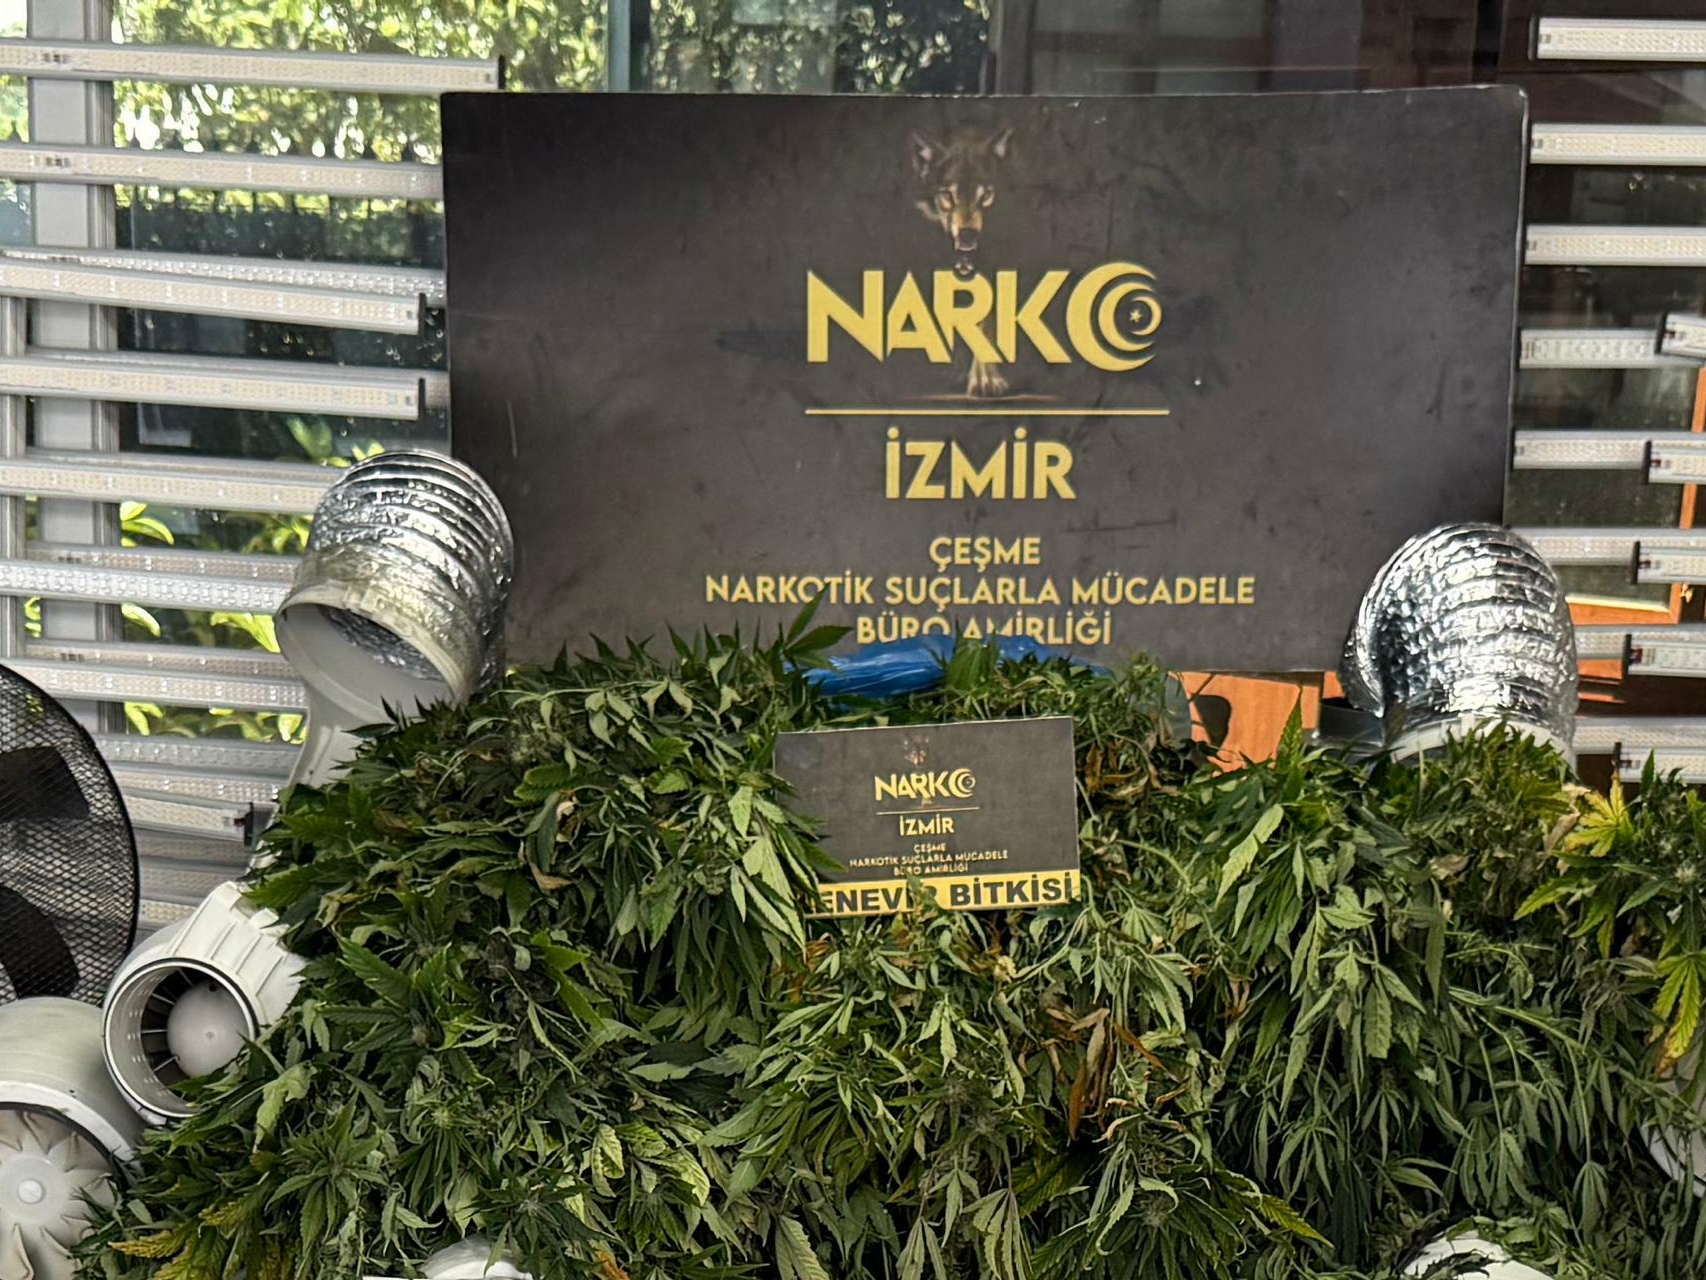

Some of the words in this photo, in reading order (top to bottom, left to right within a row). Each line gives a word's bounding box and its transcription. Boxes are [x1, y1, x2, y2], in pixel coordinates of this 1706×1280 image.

[807, 261, 1162, 372] NARKO
[886, 427, 1075, 501] İZMİR
[929, 537, 1041, 572] ÇEŞME
[705, 570, 873, 605] NARKOTİK
[885, 577, 1059, 611] SUÇLARLA
[1071, 570, 1255, 605] MÜCADELE
[857, 611, 951, 644] BÜRO
[874, 768, 976, 801] NARKO
[899, 813, 955, 837] İZMİR
[949, 871, 1074, 907] BİTKİSİ
